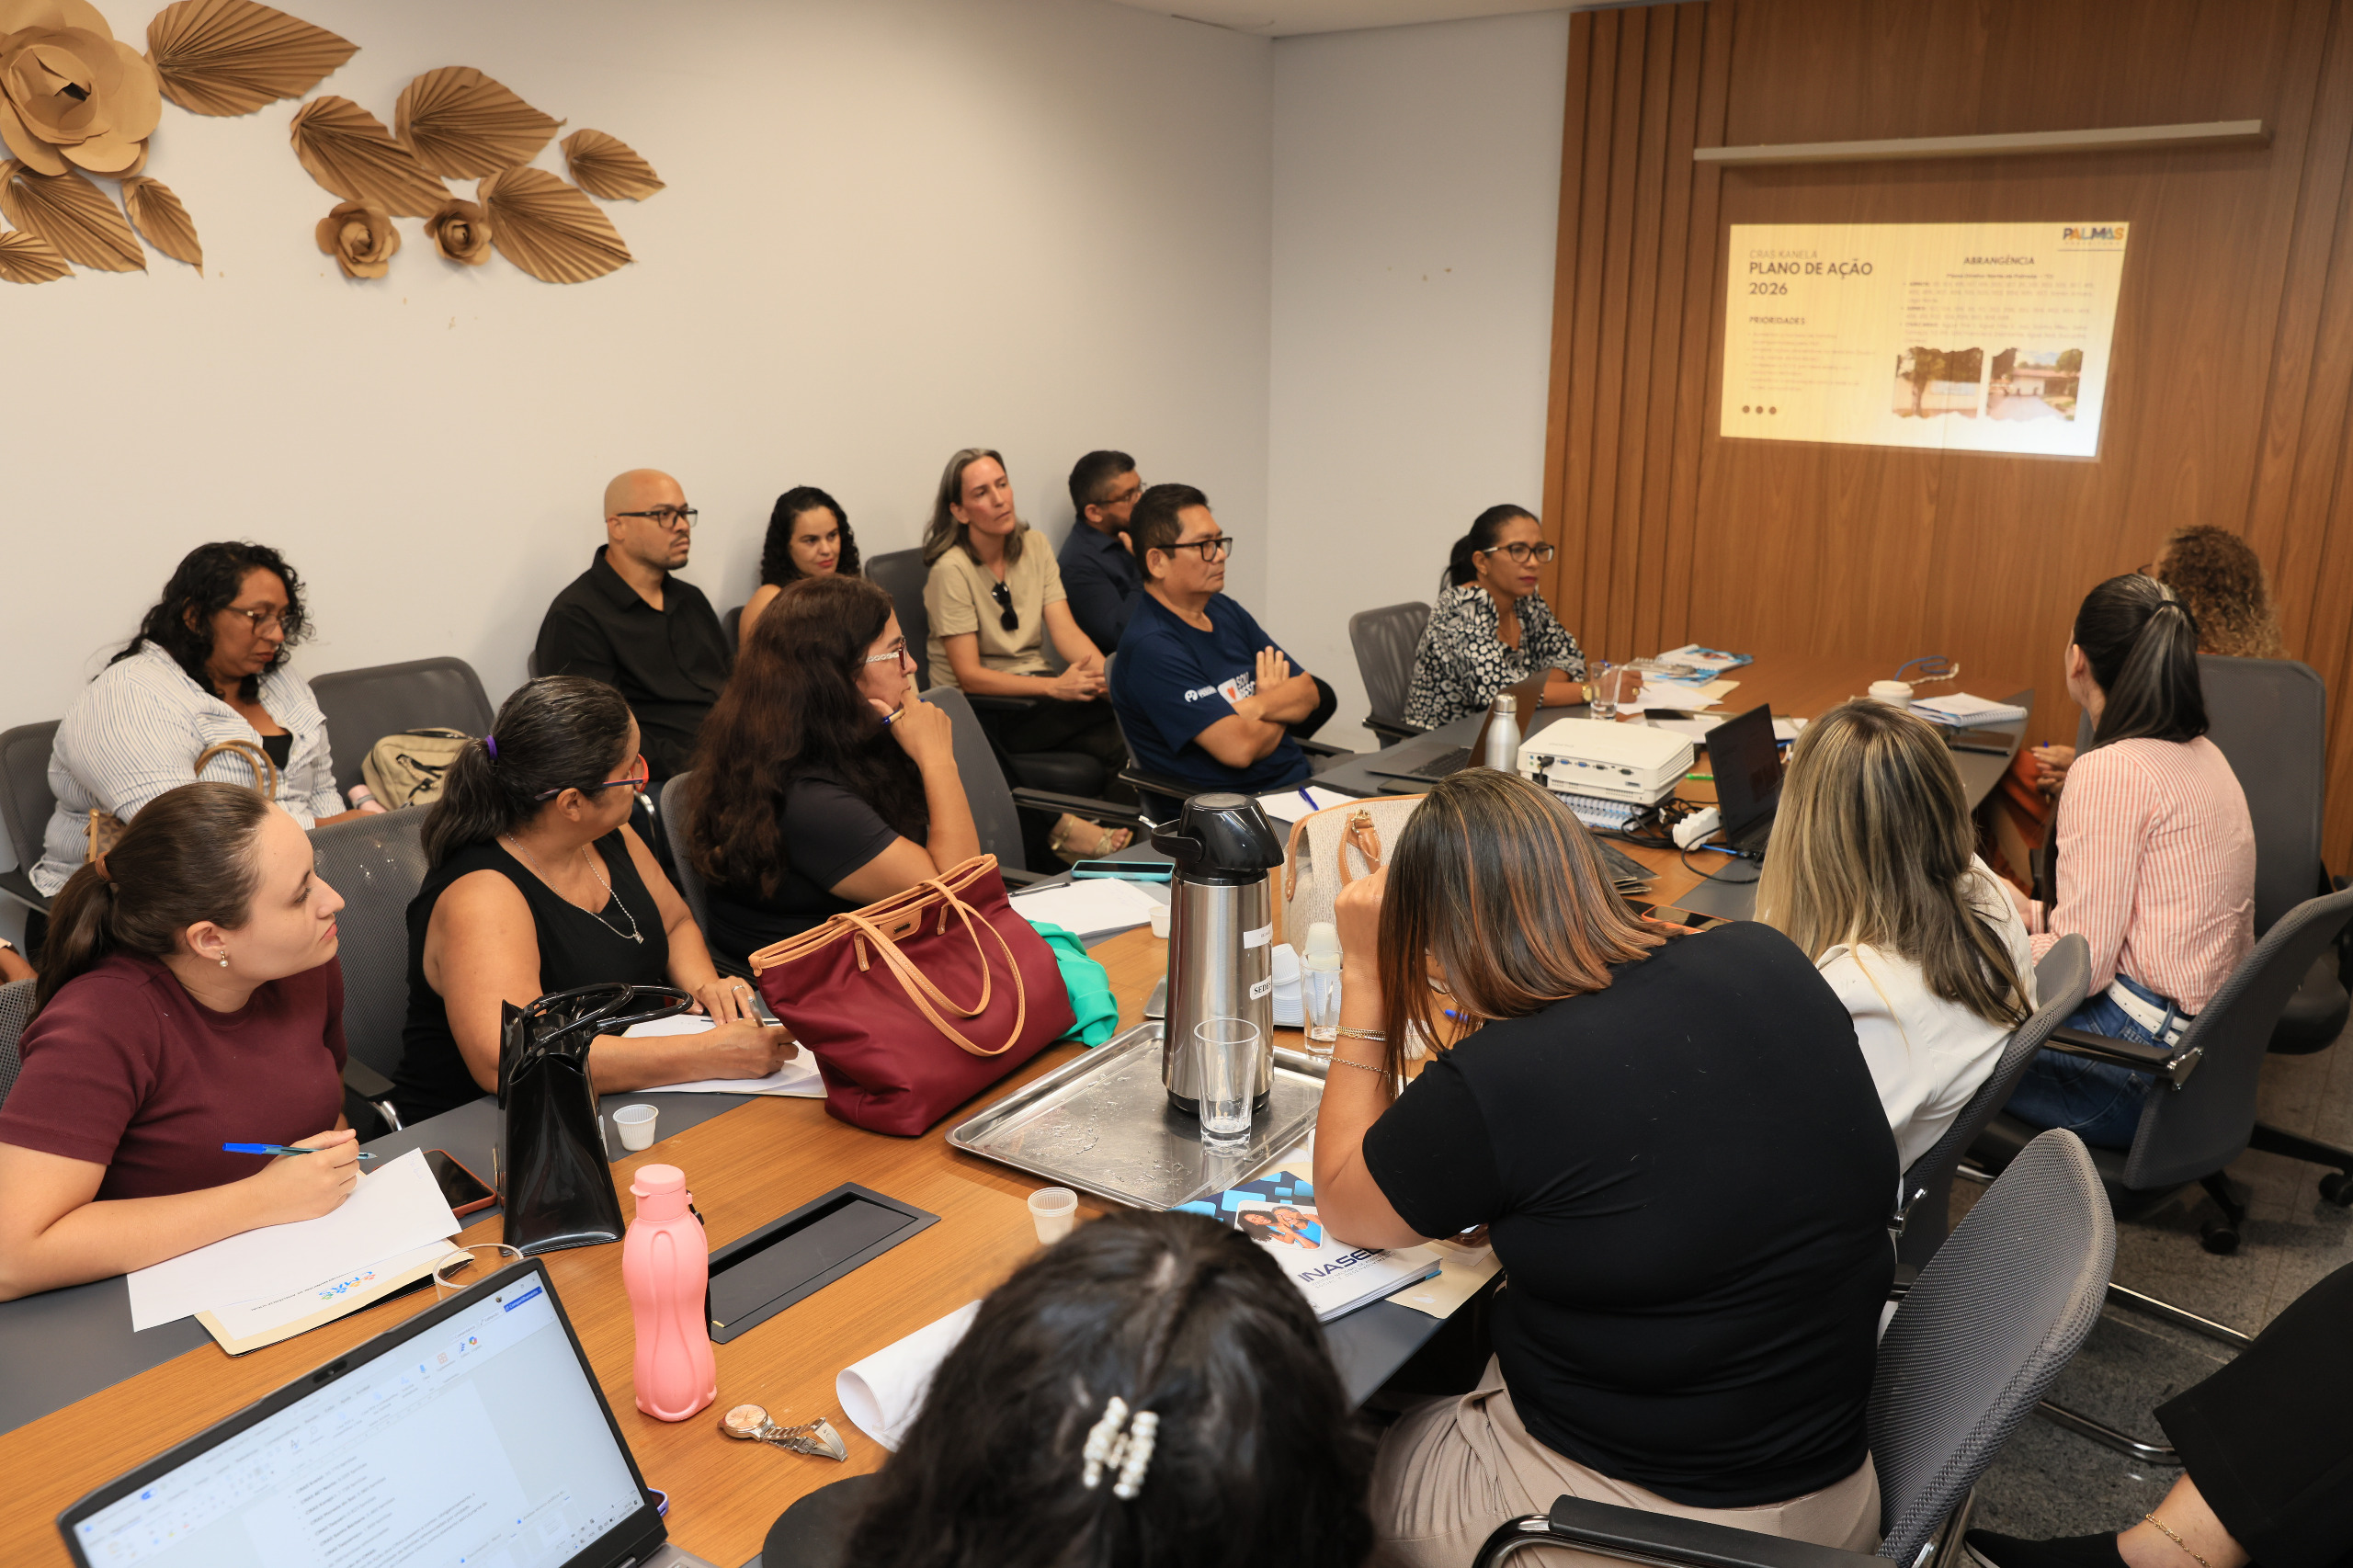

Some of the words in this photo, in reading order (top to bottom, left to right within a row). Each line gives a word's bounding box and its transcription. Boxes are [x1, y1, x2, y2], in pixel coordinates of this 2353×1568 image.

[2063, 227, 2125, 241] PALMAS
[1749, 249, 1776, 259] CRAS
[1963, 254, 2035, 266] ABRANGÊNCIA
[1749, 262, 1801, 275] PLANO
[1805, 262, 1823, 275] DE
[1827, 257, 1873, 280] AÇÃO
[1749, 282, 1788, 295] 2026
[1749, 316, 1805, 325] PRIORIDADES
[319, 1271, 373, 1296] CMAS
